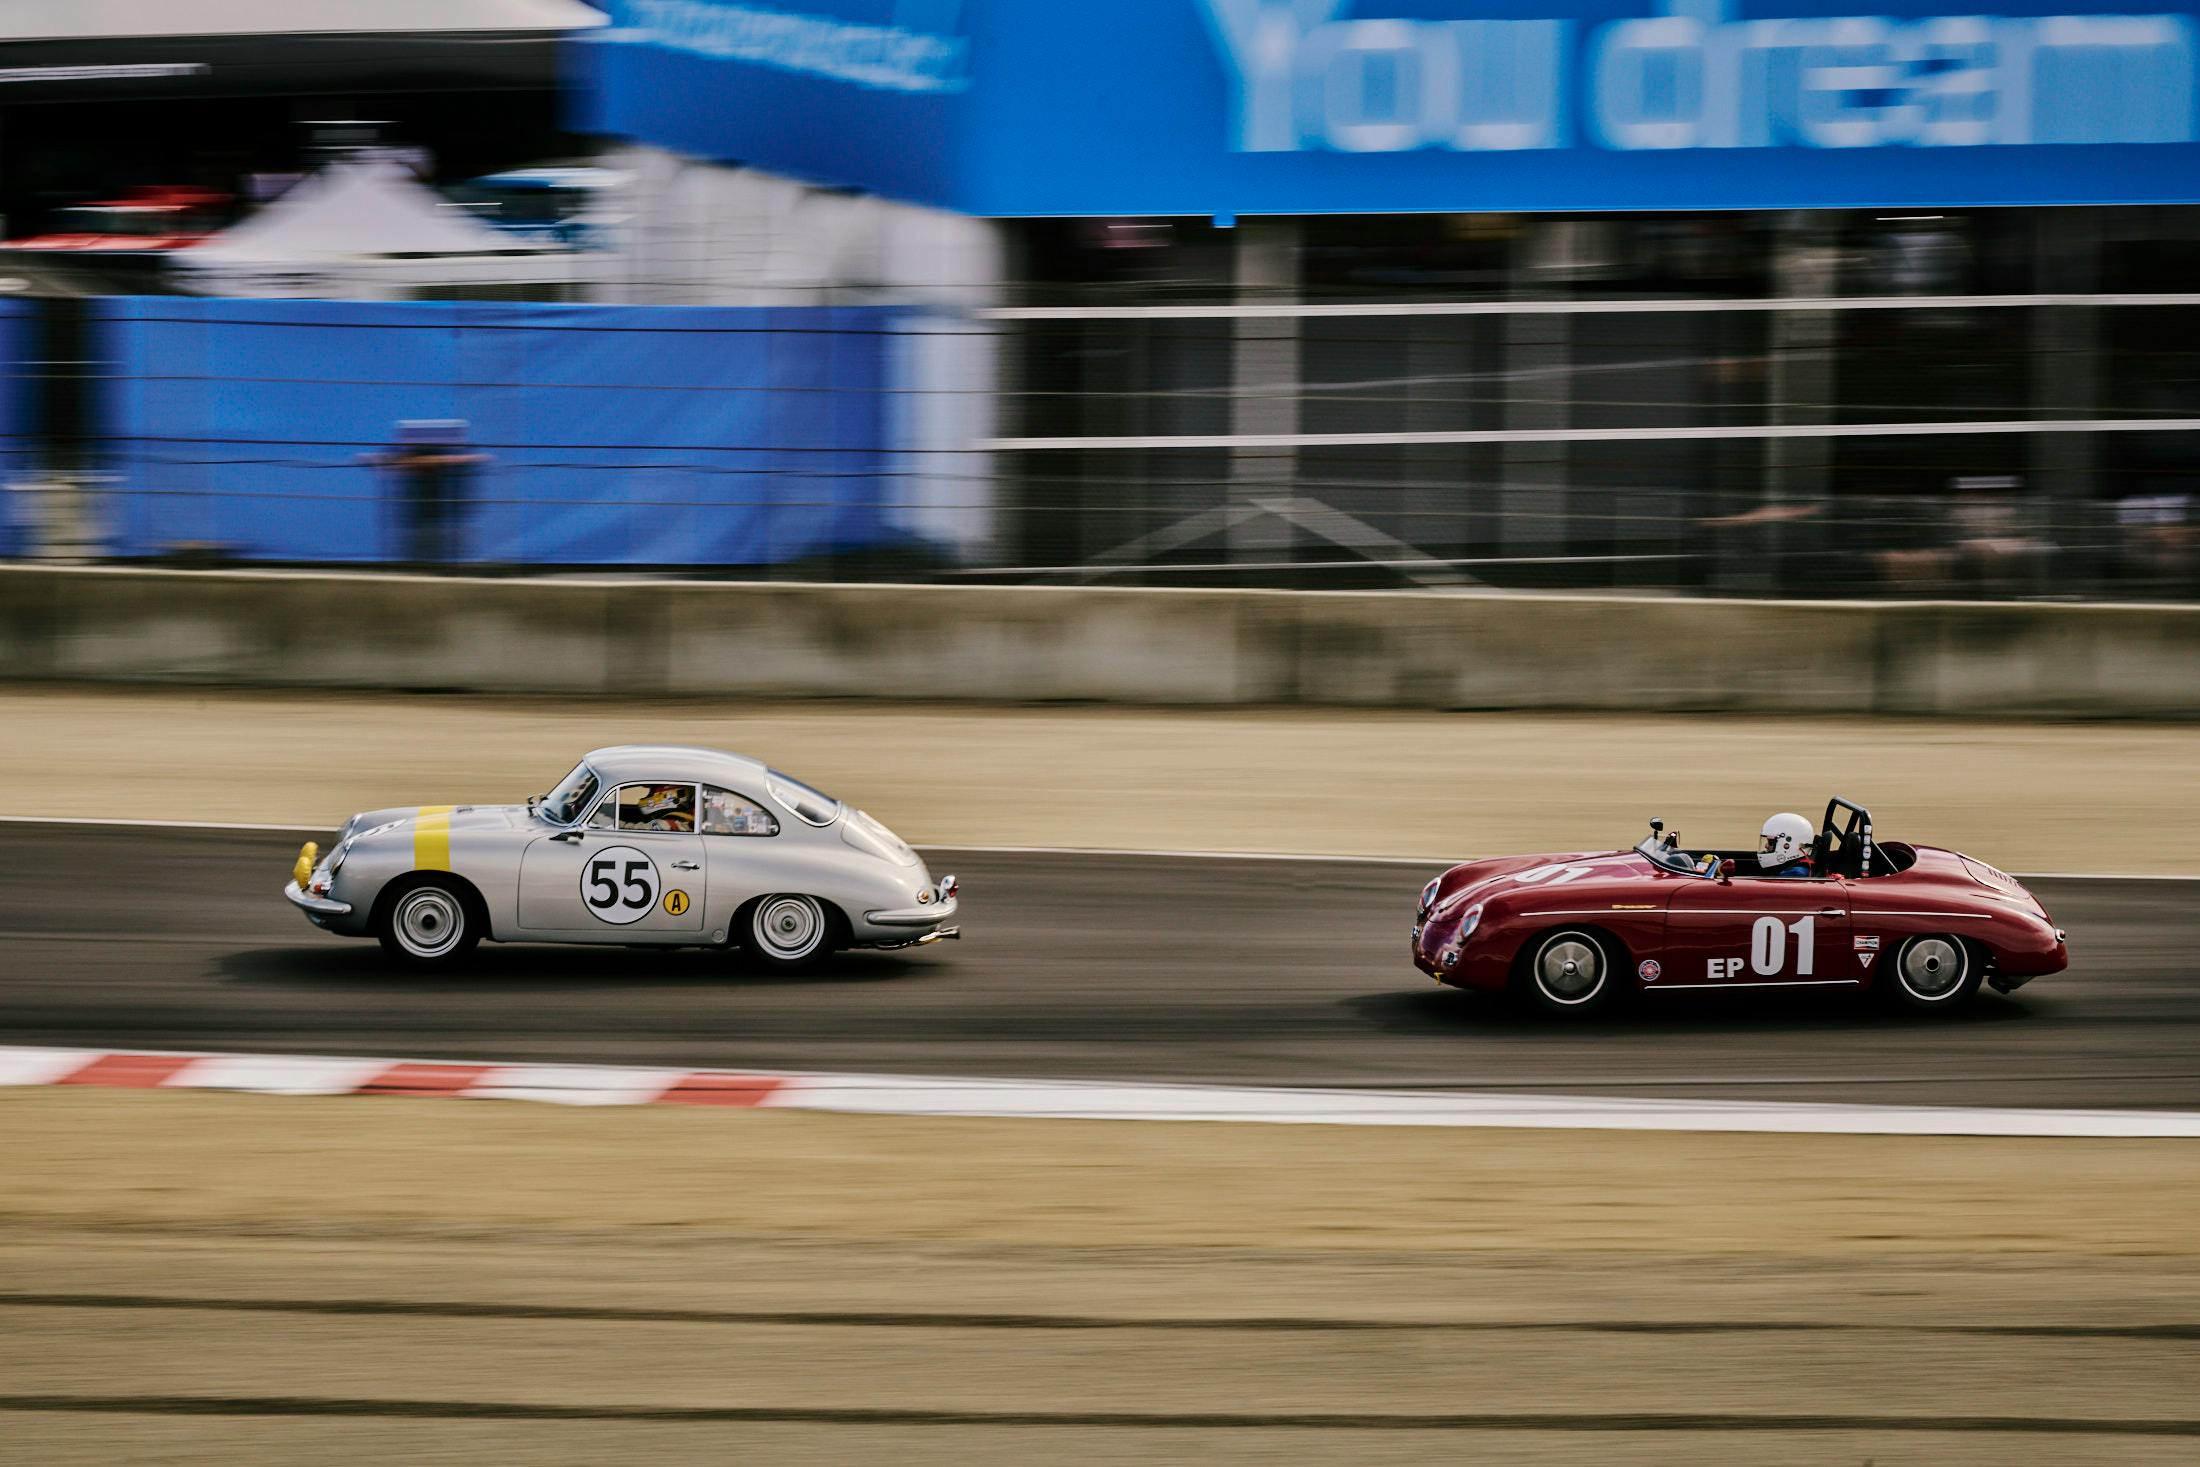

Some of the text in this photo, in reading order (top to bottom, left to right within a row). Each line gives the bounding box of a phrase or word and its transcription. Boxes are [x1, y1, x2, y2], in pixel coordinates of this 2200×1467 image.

[1215, 0, 2196, 152] You dream
[589, 860, 652, 909] 55
[1514, 863, 1594, 885] 01
[671, 893, 681, 911] A
[1706, 957, 1745, 978] EP
[1750, 915, 1814, 976] 01
